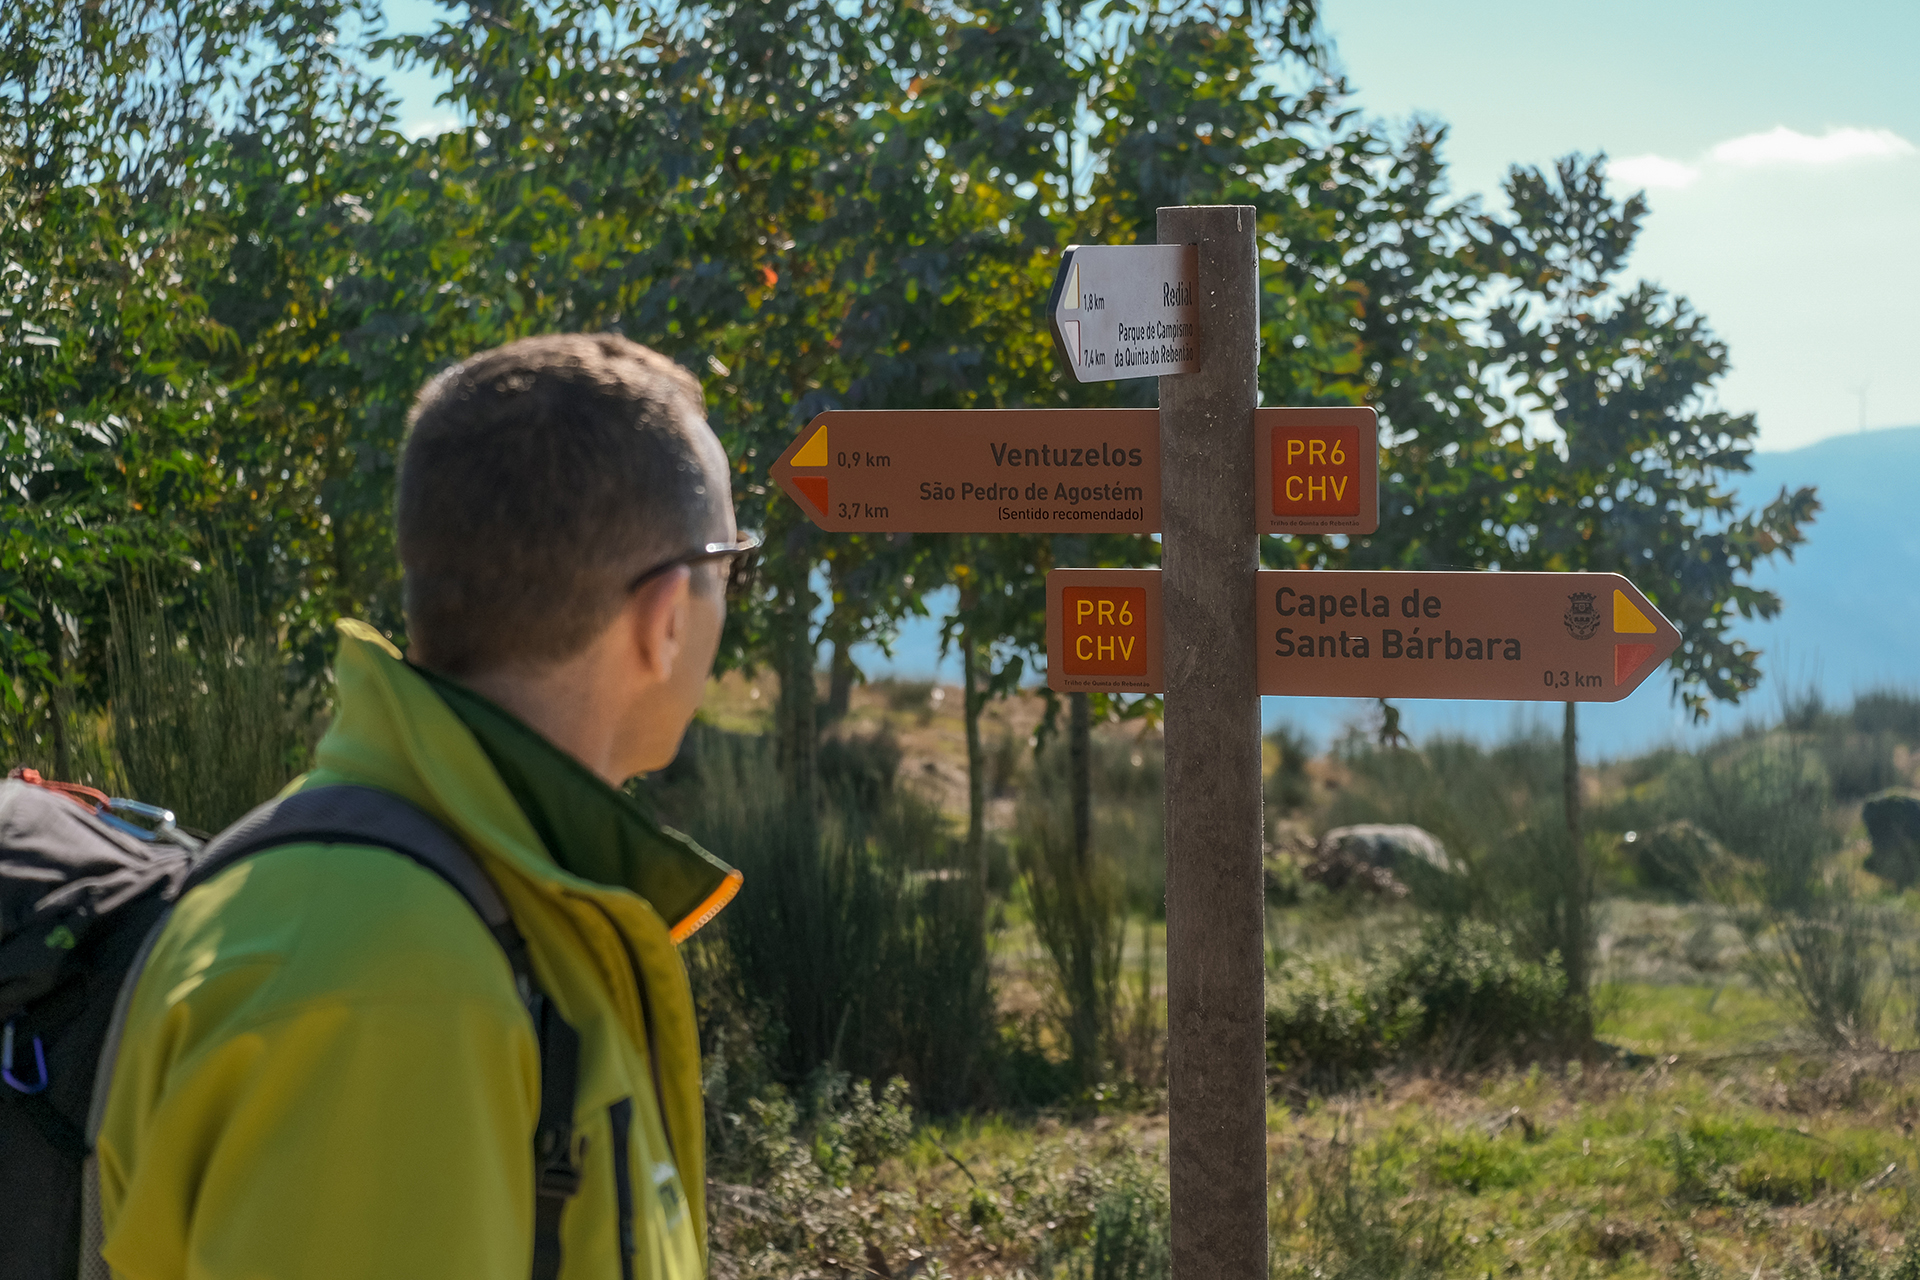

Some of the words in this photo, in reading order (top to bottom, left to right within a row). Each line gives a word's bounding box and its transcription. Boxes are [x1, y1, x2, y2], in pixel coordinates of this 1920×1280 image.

[1083, 293, 1094, 312] 1,8
[1094, 293, 1105, 311] km
[1163, 281, 1192, 307] Redial
[1118, 322, 1145, 345] Parque
[1146, 321, 1155, 340] de
[1156, 319, 1193, 342] Campismo
[1084, 350, 1094, 367] 7,4
[1095, 349, 1106, 366] km
[1114, 348, 1124, 367] da
[1125, 346, 1149, 367] Quinta
[1150, 345, 1160, 364] do
[1160, 342, 1194, 363] Rebentão
[837, 452, 861, 470] 0,9
[865, 451, 891, 468] km
[990, 442, 1143, 467] Ventuzelos
[1287, 439, 1346, 465] PR6
[919, 481, 956, 501] São
[961, 481, 1019, 501] Pedro
[1024, 482, 1049, 501] de
[1053, 480, 1143, 505] Agostém
[1285, 475, 1348, 501] CHV
[838, 502, 861, 521] 3,7
[864, 502, 889, 518] km
[998, 506, 1050, 521] (Sentido
[1052, 506, 1144, 521] recomendado)
[1077, 600, 1134, 626] PR6
[1275, 586, 1390, 624] Capela
[1401, 588, 1442, 618] de
[1076, 635, 1135, 661] CHV
[1275, 627, 1370, 659] Santa
[1382, 627, 1522, 661] Bárbara
[1543, 671, 1570, 689] 0,3
[1575, 670, 1603, 688] km
